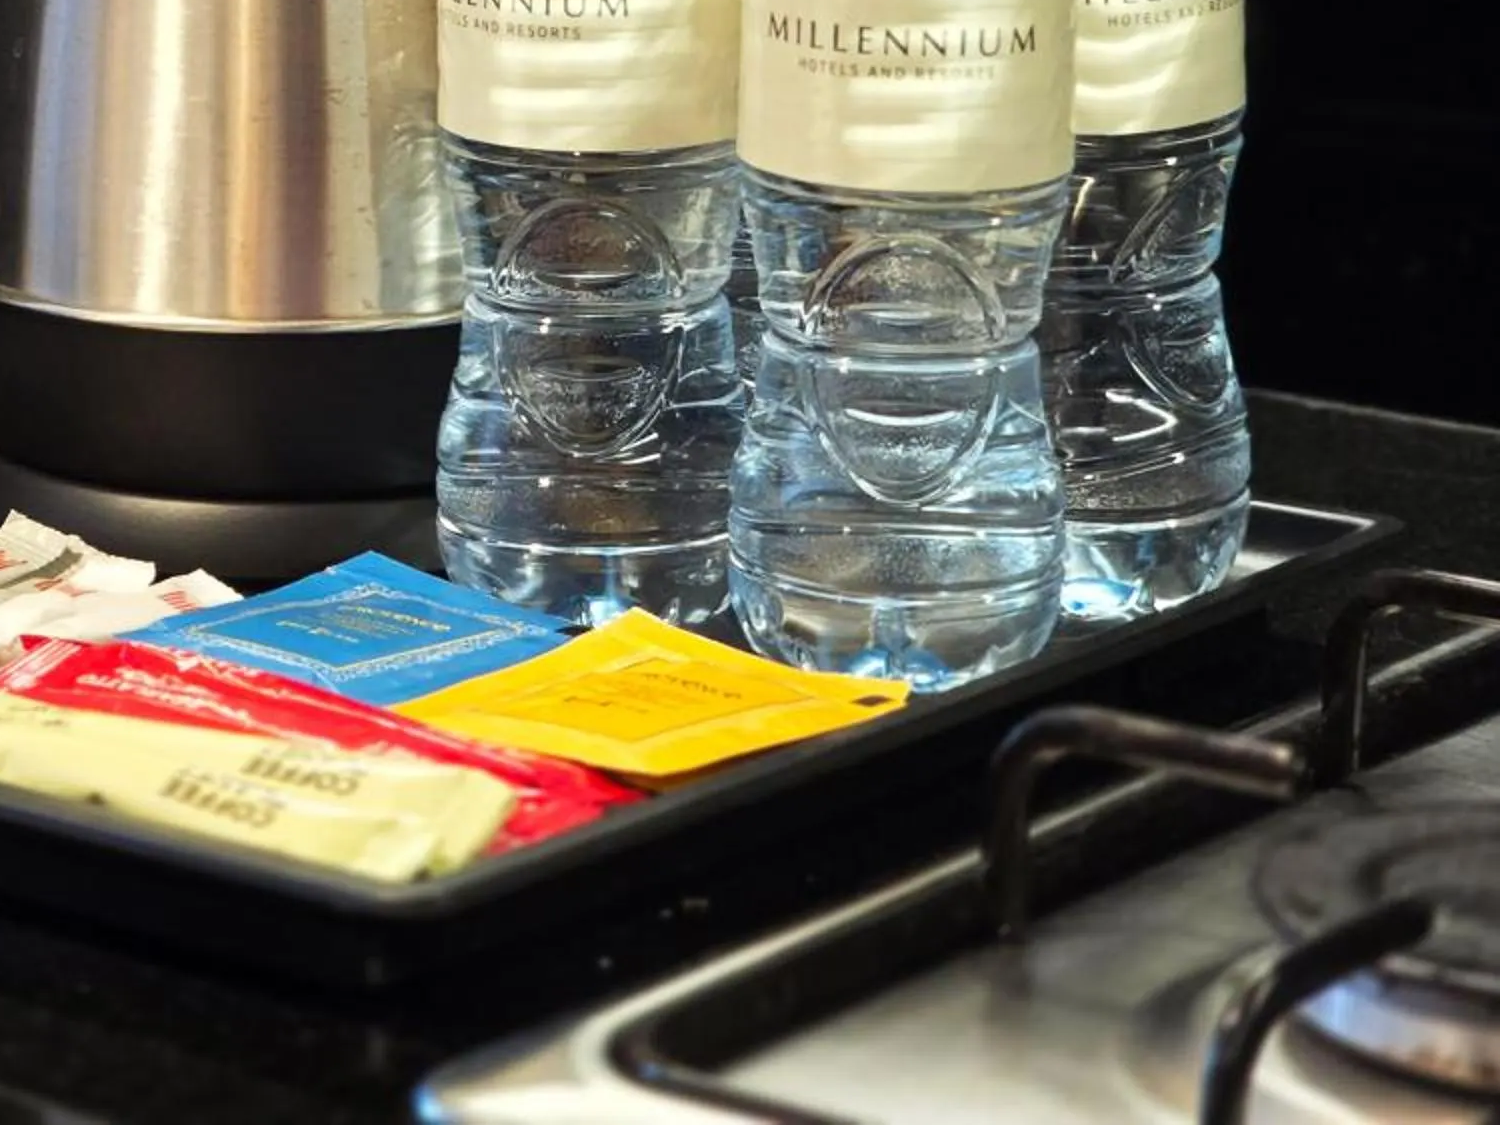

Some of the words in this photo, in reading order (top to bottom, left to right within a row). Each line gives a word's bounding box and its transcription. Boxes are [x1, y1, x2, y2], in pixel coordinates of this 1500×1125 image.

[473, 18, 500, 35] AND
[506, 22, 581, 41] RESORTS
[1107, 9, 1172, 28] HOTELS
[767, 12, 1037, 57] MILLENNIUM
[797, 55, 859, 78] HOTELS
[866, 66, 906, 80] AND
